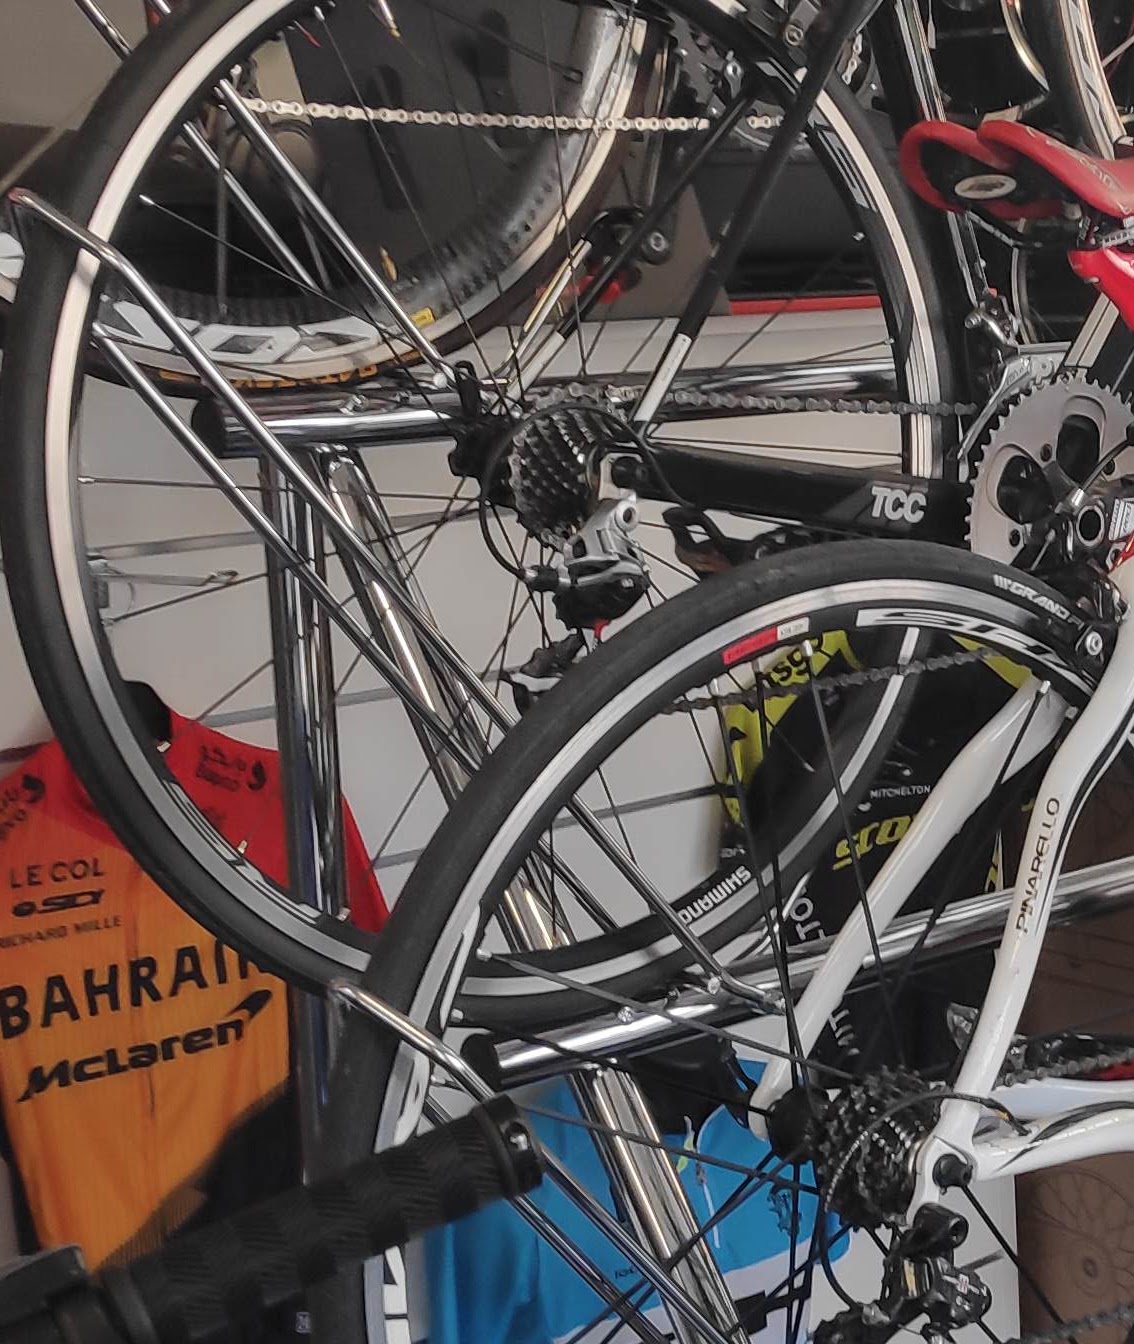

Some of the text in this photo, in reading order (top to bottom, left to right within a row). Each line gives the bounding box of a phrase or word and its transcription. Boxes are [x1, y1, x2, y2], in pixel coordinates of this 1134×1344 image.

[871, 485, 927, 524] TCC
[10, 857, 107, 889] LE COL
[1015, 797, 1061, 934] PINARELLO
[16, 1019, 244, 1103] McLaren
